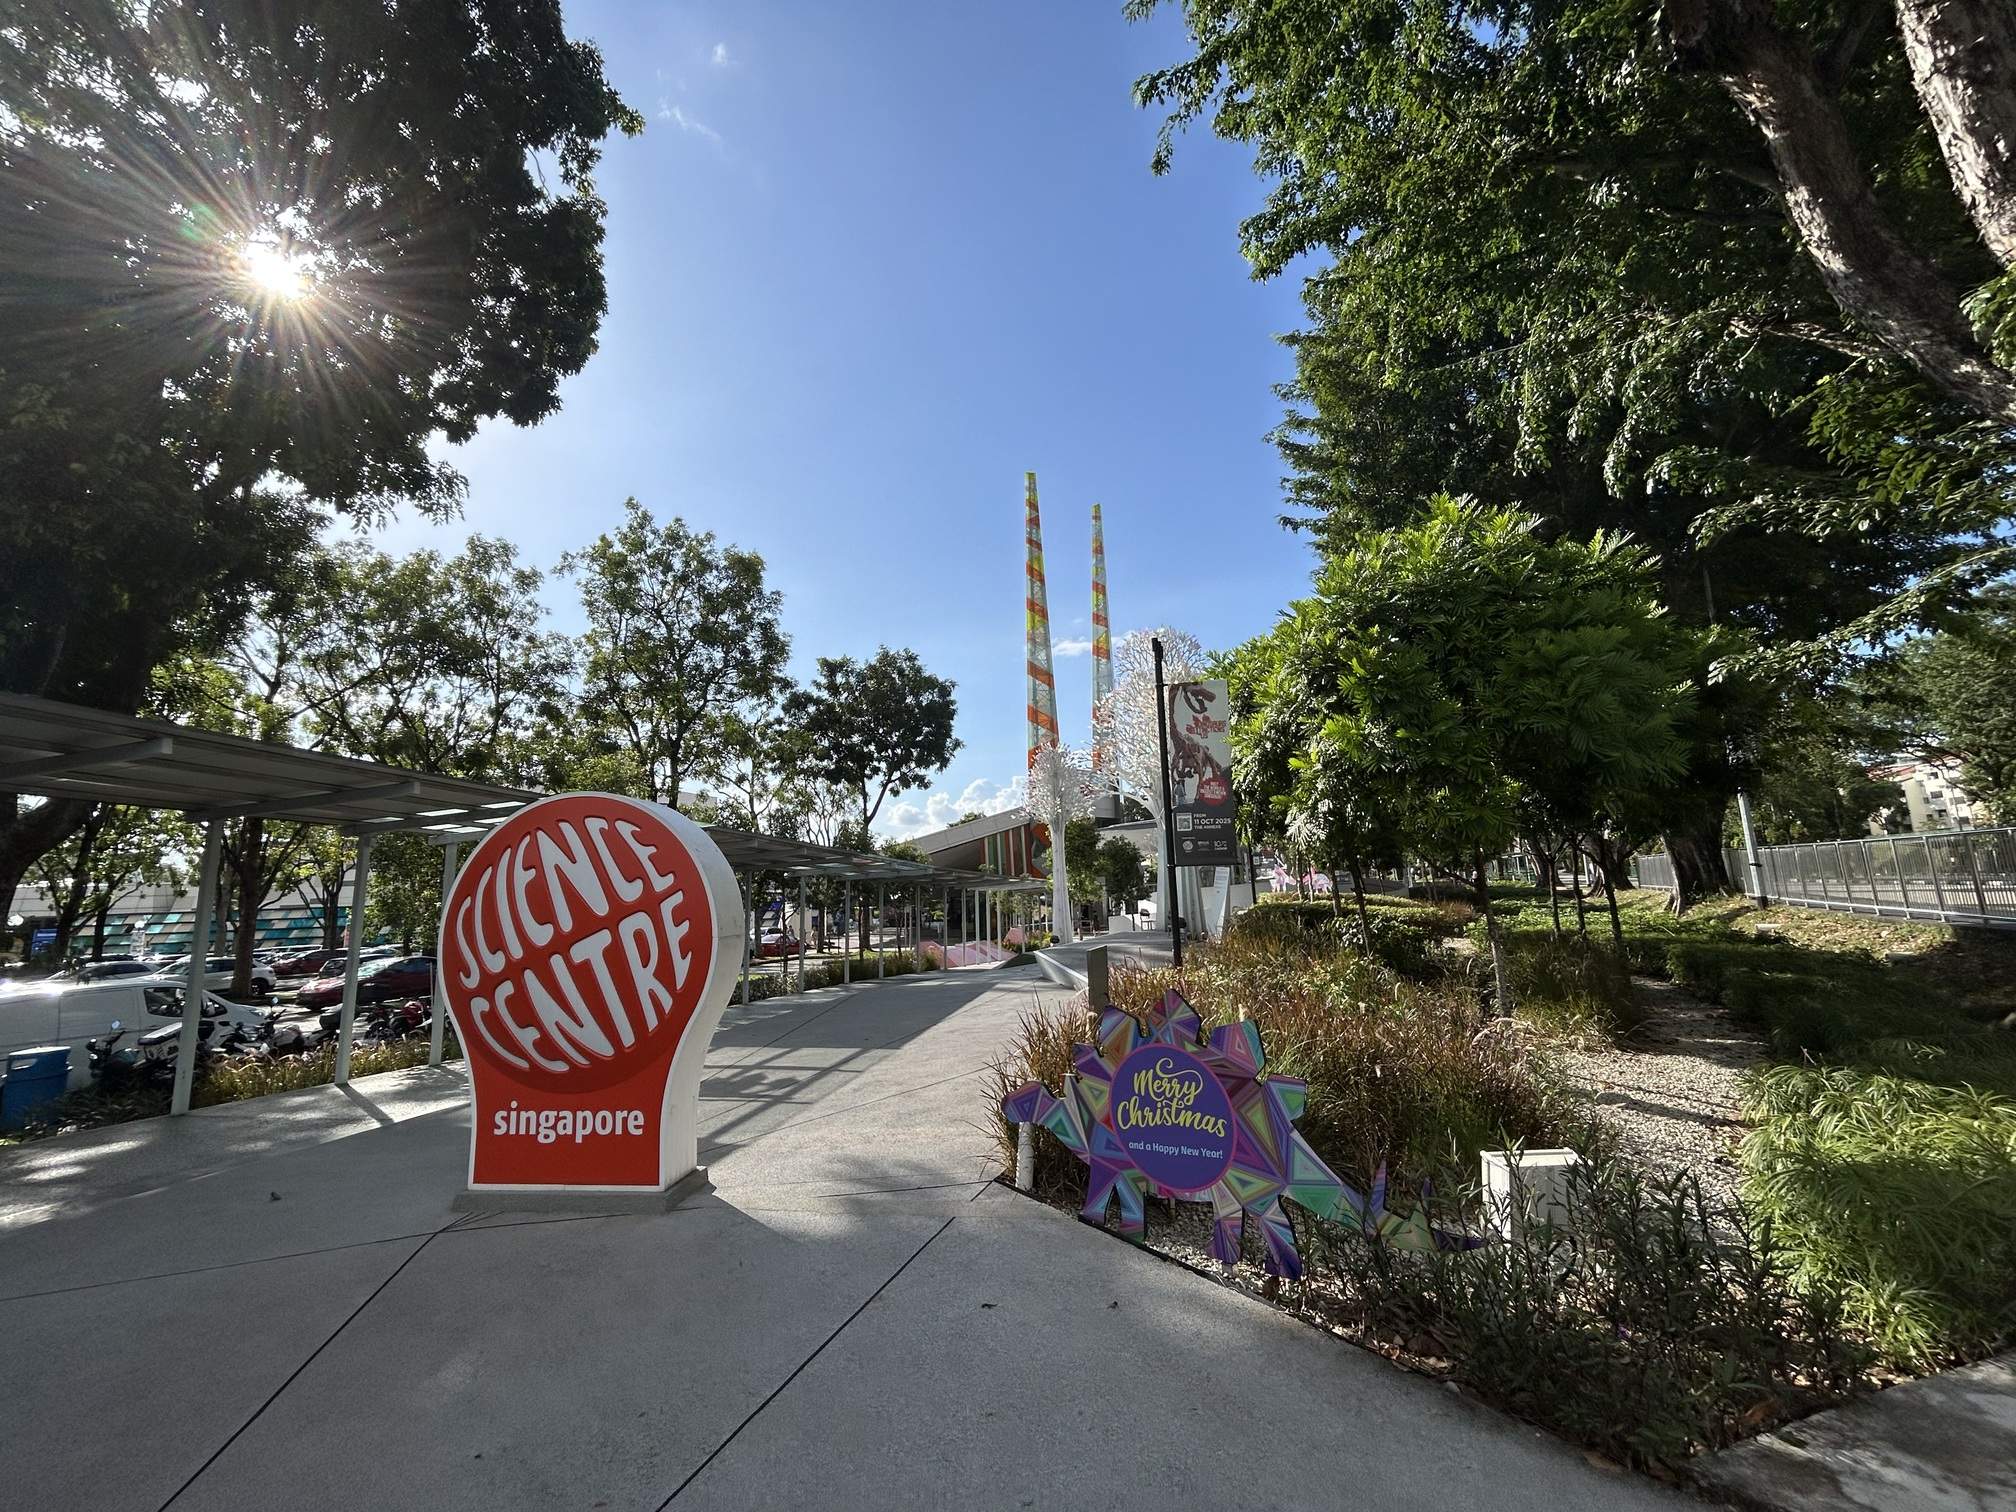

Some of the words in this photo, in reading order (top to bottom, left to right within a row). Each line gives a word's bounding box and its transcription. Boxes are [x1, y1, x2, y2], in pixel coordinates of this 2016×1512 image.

[456, 816, 675, 990] SCIENCE
[471, 890, 692, 1072] CENTRE
[1133, 1057, 1203, 1105] Merry
[493, 1100, 645, 1143] singapore
[1117, 1095, 1227, 1138] Christmas
[1128, 1140, 1144, 1151] and
[1145, 1143, 1151, 1151] a
[1152, 1142, 1180, 1156] Happy
[1181, 1145, 1199, 1156] New
[1200, 1147, 1224, 1160] Year!
